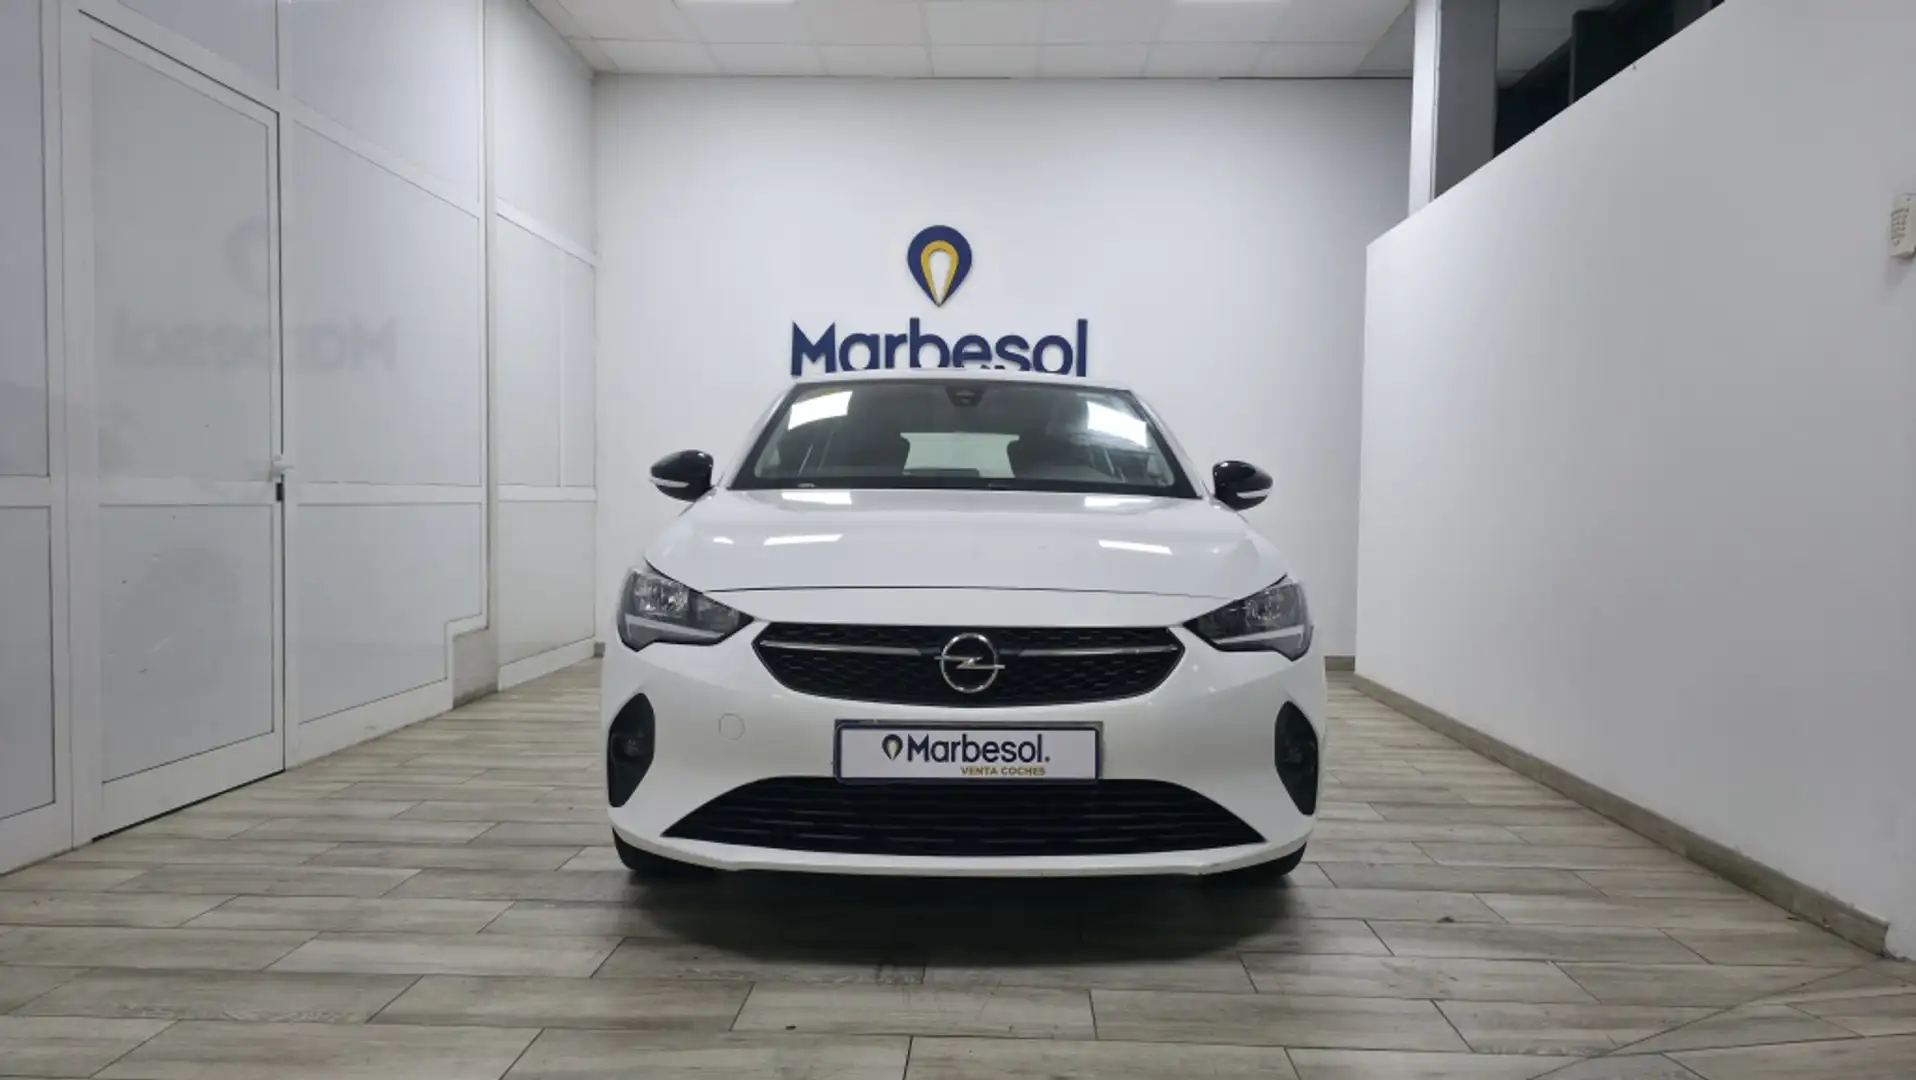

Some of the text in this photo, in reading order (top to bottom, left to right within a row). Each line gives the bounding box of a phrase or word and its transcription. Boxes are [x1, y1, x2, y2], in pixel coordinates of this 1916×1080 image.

[791, 317, 1088, 377] Marbesol
[907, 733, 1051, 763] Marbesol.
[960, 766, 1046, 776] VENTA COCHES
